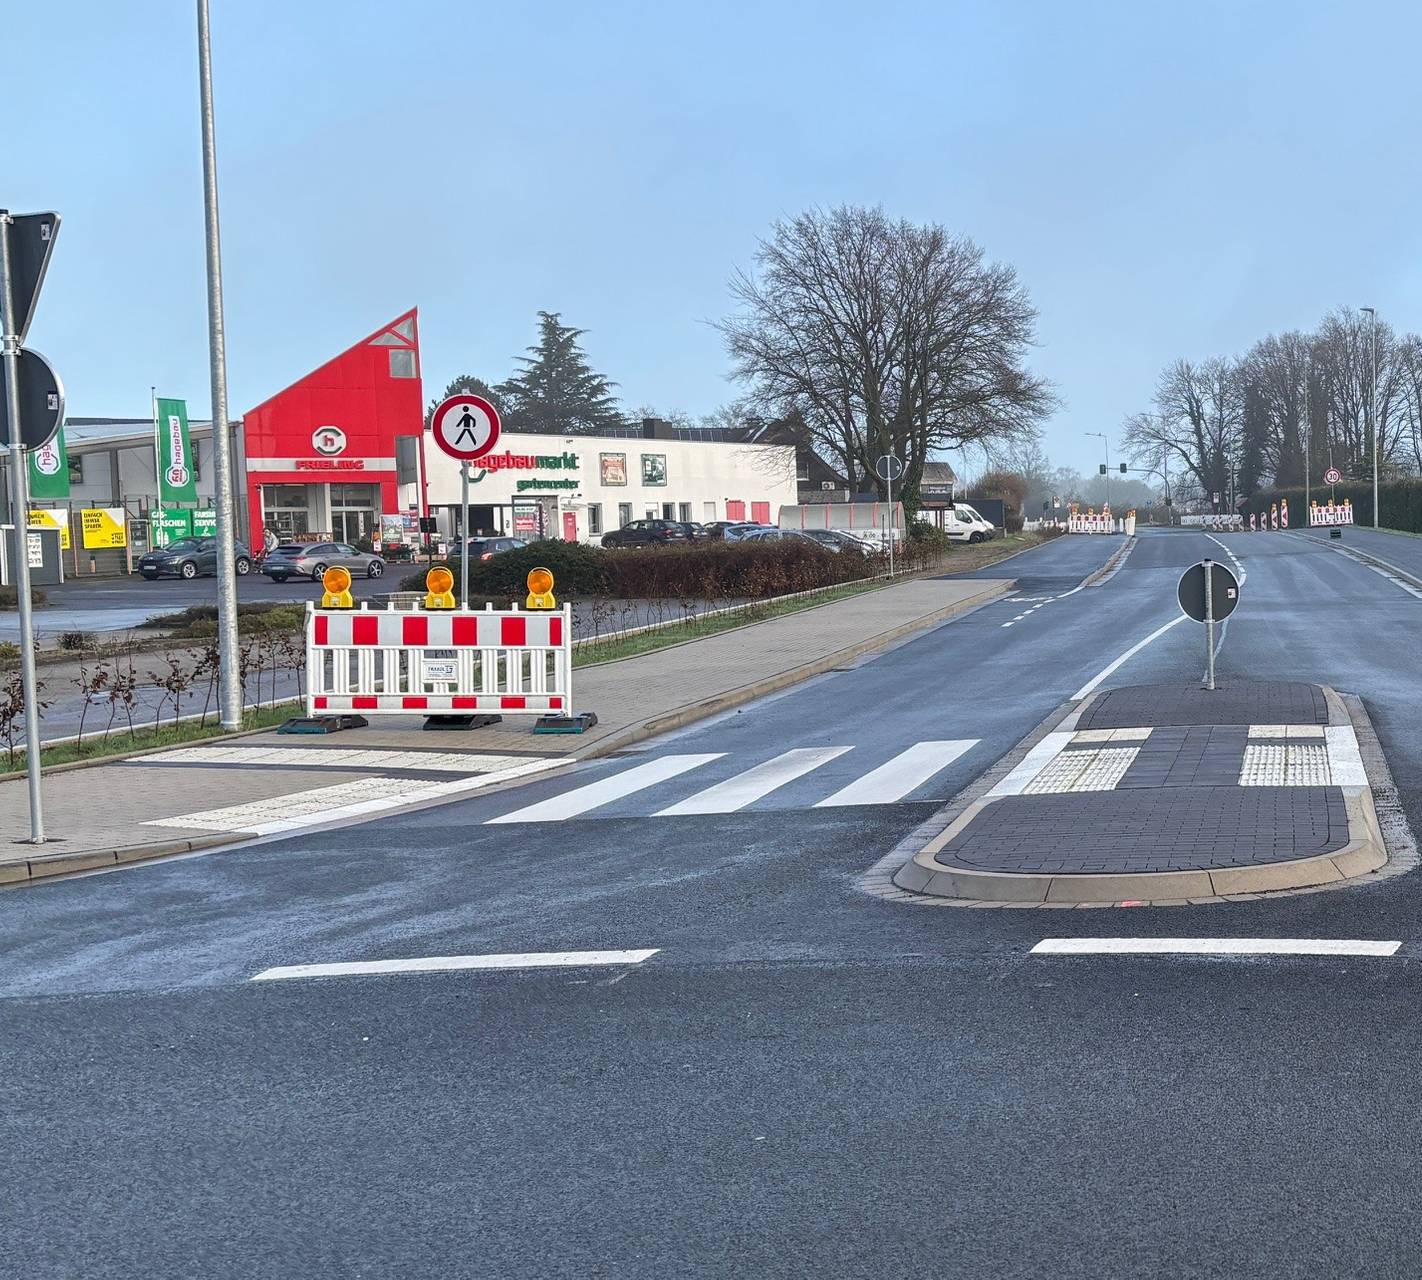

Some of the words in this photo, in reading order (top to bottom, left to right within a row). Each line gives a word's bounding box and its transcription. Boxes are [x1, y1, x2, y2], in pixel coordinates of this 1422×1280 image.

[295, 460, 365, 470] FRIELING
[474, 450, 580, 473] agebaumarkt
[516, 478, 580, 492] gartencenter
